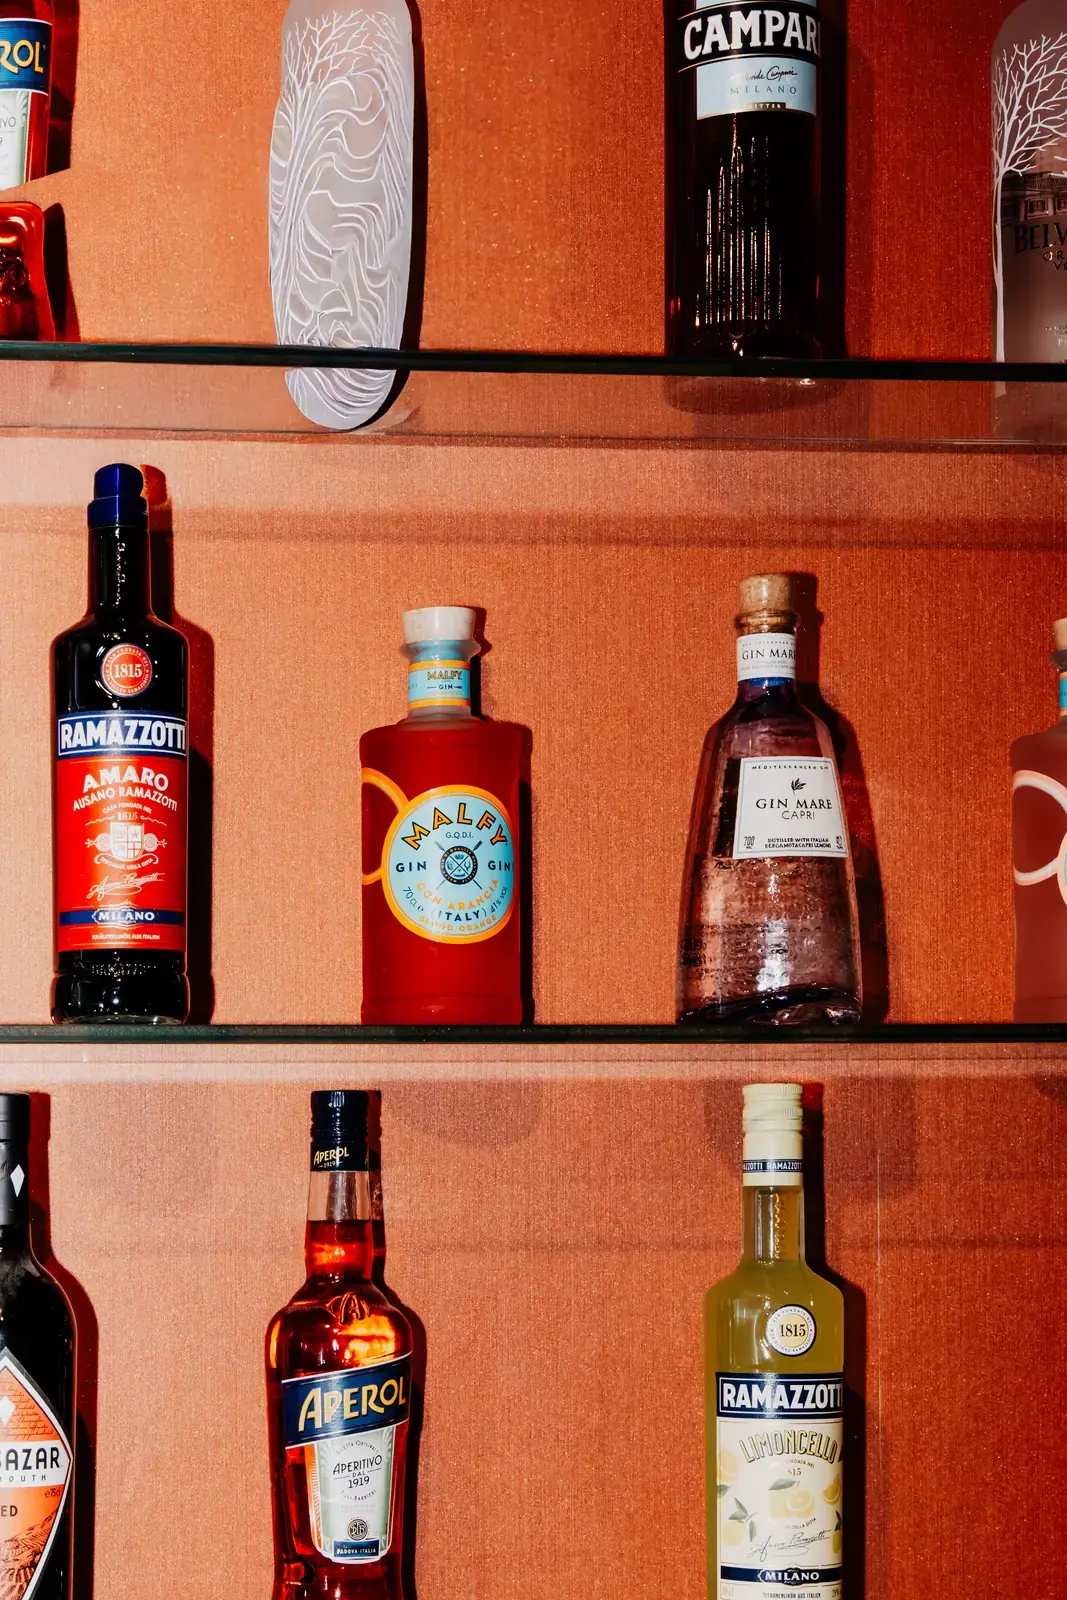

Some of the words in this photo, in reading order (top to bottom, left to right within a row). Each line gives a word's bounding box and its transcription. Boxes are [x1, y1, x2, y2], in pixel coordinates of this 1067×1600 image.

[730, 85, 797, 95] MILANO
[742, 649, 765, 660] GIN
[114, 663, 143, 679] 1815
[427, 670, 464, 681] MALFY
[83, 765, 169, 793] AMARO
[73, 787, 115, 811] AUSANO
[118, 786, 178, 812] RAMAZZOTTI
[755, 798, 789, 810] GIN
[796, 799, 833, 810] MARE
[117, 811, 139, 821] 1815
[781, 810, 816, 820] CAPRI
[401, 802, 508, 850] MALFY
[445, 831, 475, 840] G.Q.D.I.
[395, 860, 428, 873] GIN
[487, 860, 512, 872] GIN
[416, 882, 442, 905] CON
[447, 879, 499, 911] ARANCIA
[98, 912, 155, 921] MILANO
[458, 914, 498, 932] ORANGE
[313, 1146, 350, 1166] APEROL
[780, 1323, 807, 1338] 1815
[298, 1376, 406, 1433] APEROL
[738, 1429, 839, 1465] LIMONCELLO
[0, 1446, 60, 1471] AZAR
[332, 1454, 383, 1476] APERITIVO
[0, 1474, 46, 1483] OUTH
[348, 1475, 370, 1489] 1919
[765, 1573, 820, 1581] MILANO
